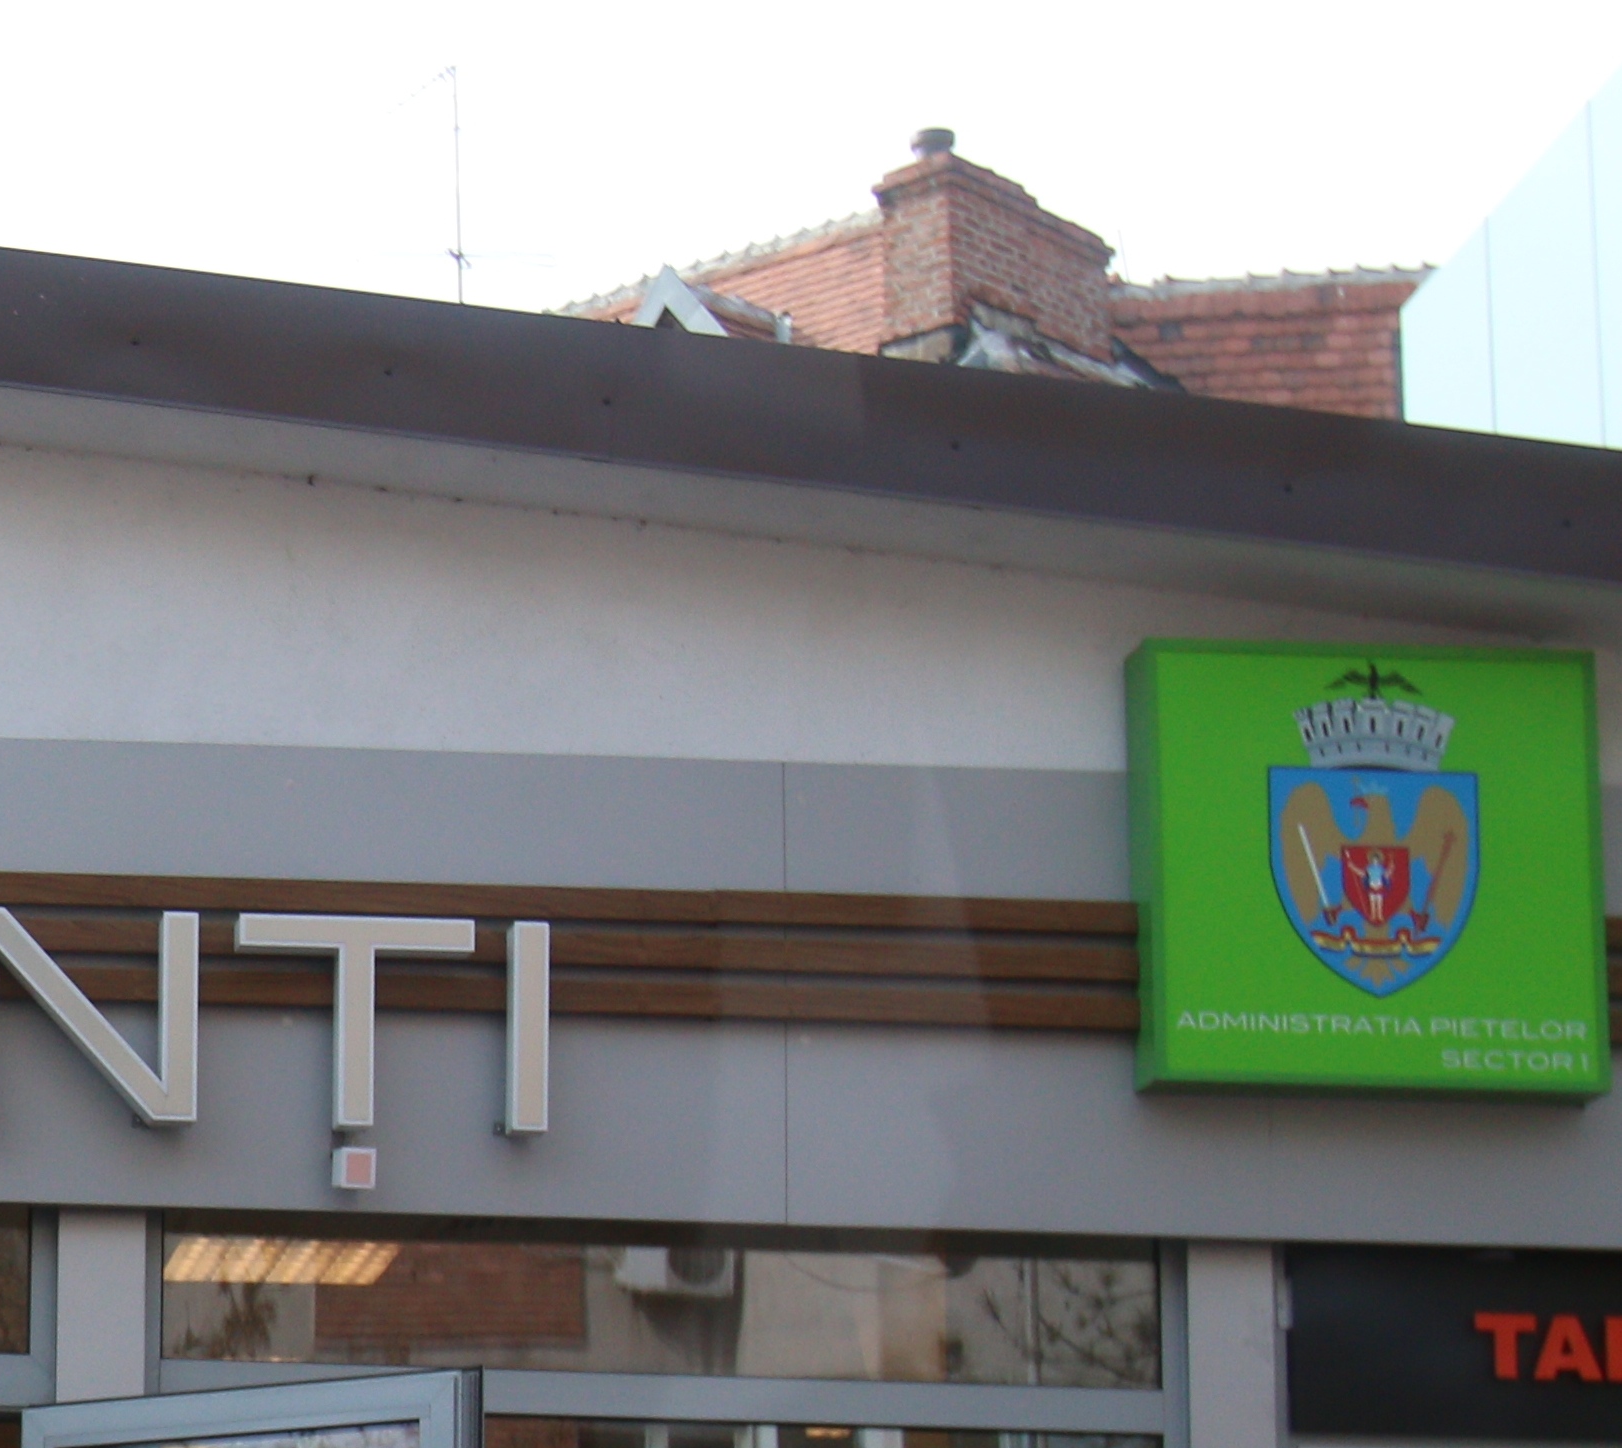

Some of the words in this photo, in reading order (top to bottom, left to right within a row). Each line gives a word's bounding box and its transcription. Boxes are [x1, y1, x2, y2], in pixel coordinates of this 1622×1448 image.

[1176, 1010, 1422, 1037] ADMINISTRATIA
[1430, 1017, 1587, 1041] PIETELOR
[1441, 1049, 1575, 1071] SECTOR
[1472, 1310, 1622, 1384] TA
